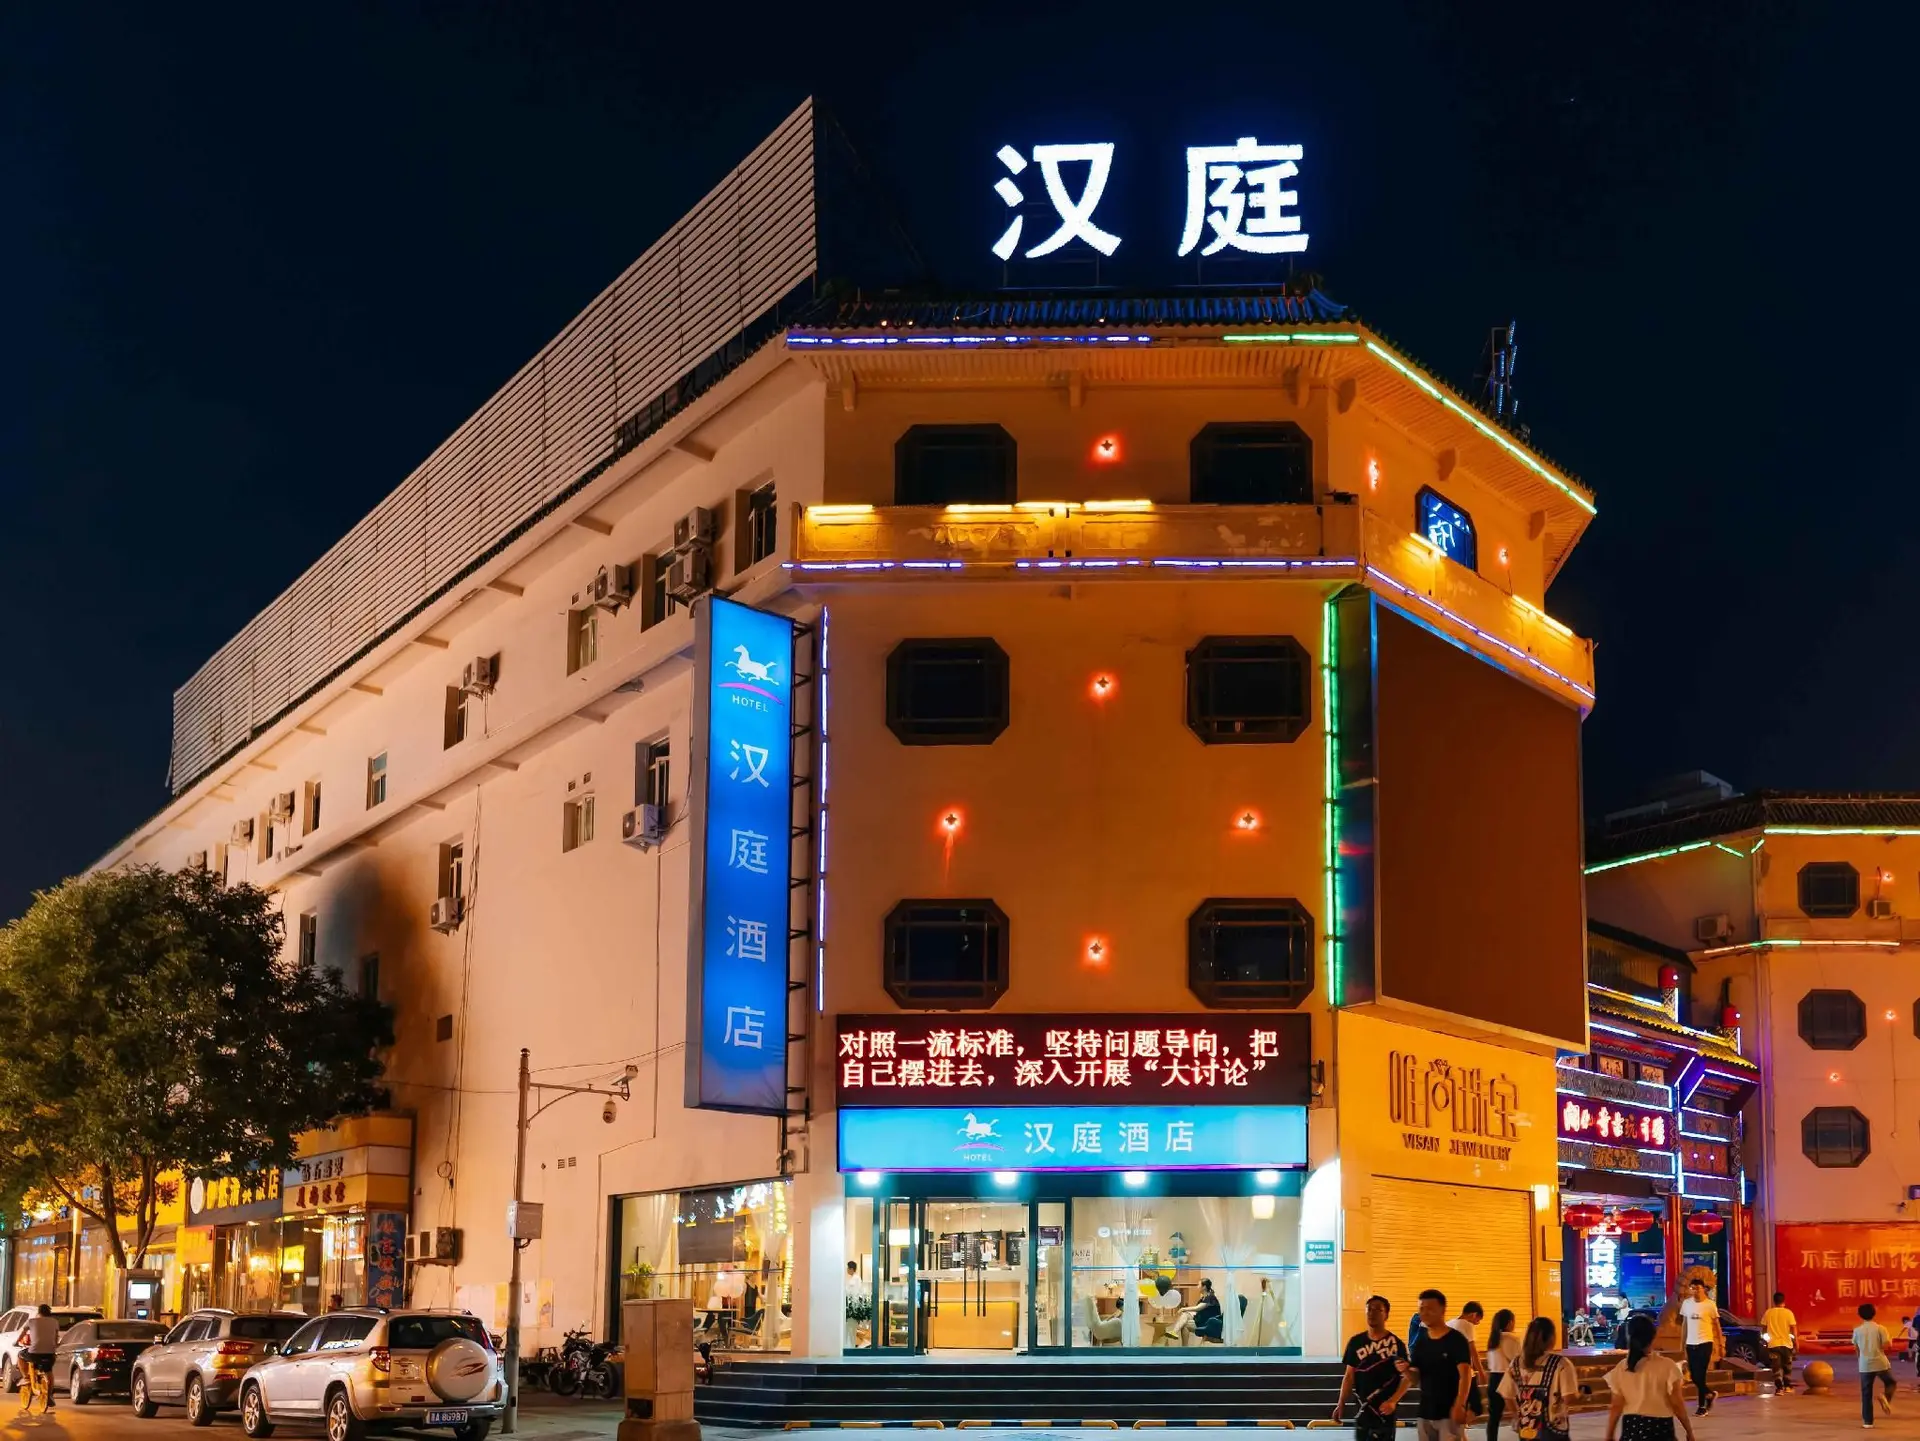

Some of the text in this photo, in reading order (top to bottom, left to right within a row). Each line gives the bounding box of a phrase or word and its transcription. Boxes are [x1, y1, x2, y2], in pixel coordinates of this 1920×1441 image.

[992, 137, 1309, 260] 汉庭
[731, 694, 769, 712] HOTEL
[723, 739, 770, 1050] 汉庭酒店
[1024, 1120, 1194, 1154] 汉庭酒店
[1402, 1133, 1512, 1161] VISAN JEWELLERY
[963, 1153, 993, 1162] HOTEL
[1589, 1235, 1617, 1288] 台球
